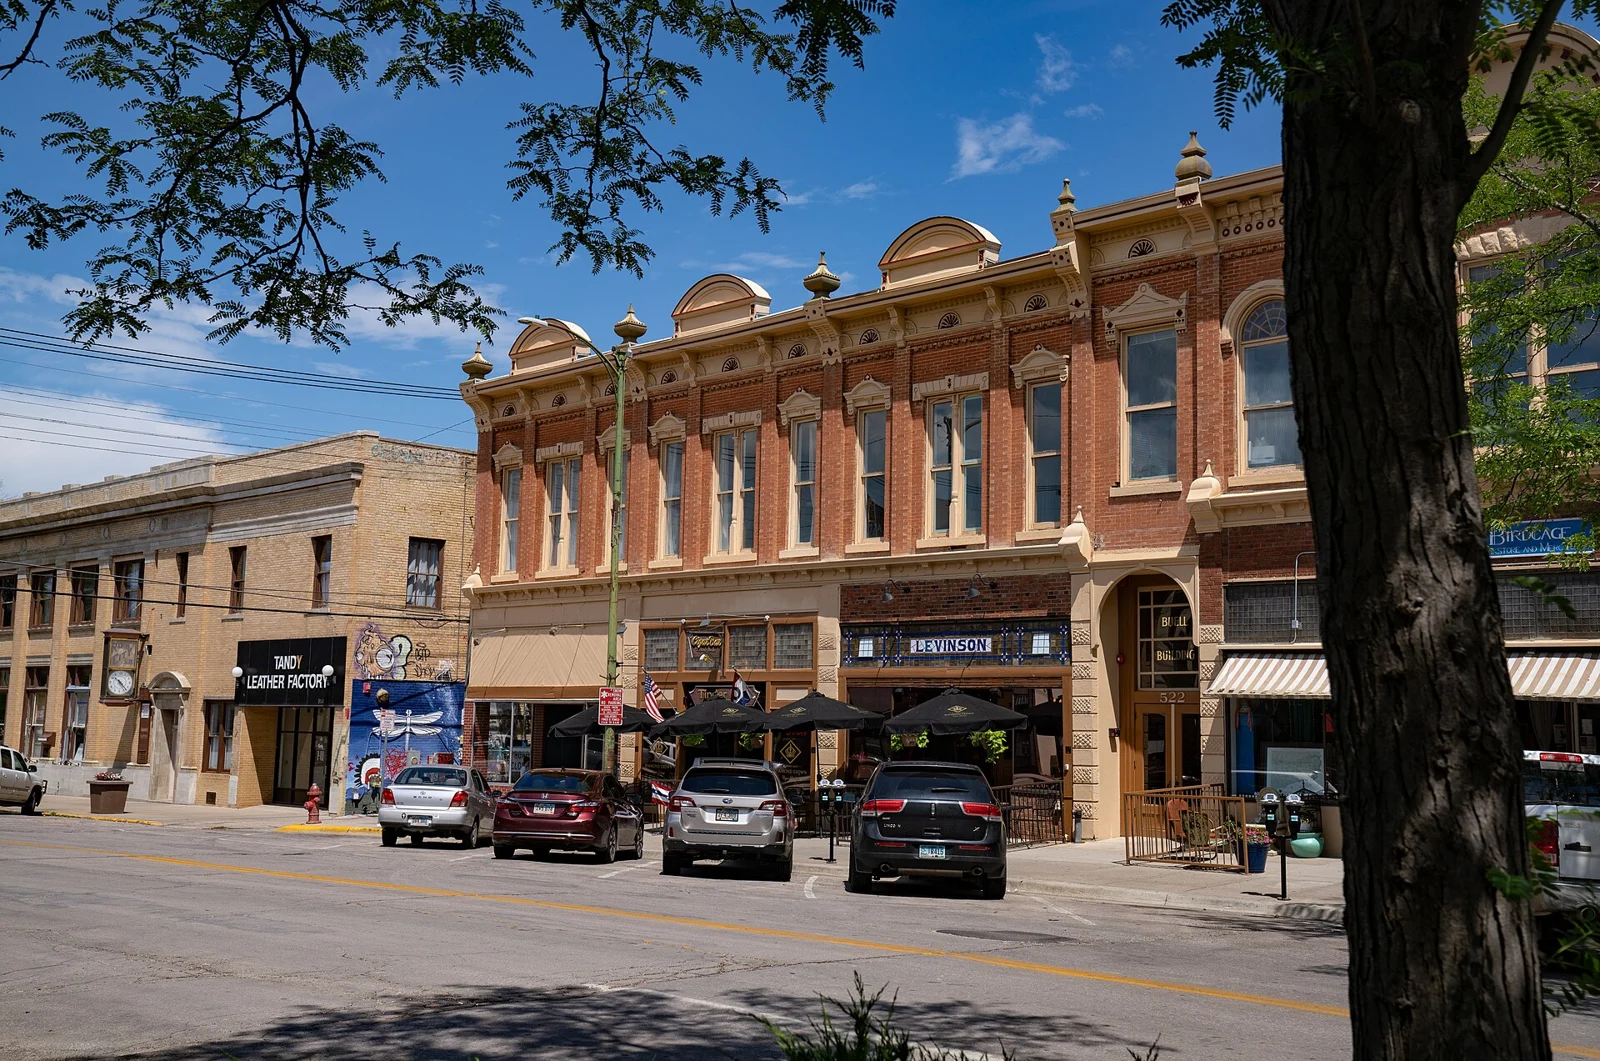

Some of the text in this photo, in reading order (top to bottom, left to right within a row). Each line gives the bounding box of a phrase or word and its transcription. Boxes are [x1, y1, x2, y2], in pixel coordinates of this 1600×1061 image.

[1489, 527, 1571, 545] BIRDCAGE
[1523, 545, 1538, 553] AND
[1162, 616, 1187, 627] BUELL
[916, 639, 987, 652] LEVINSON
[1157, 649, 1195, 661] BUILDING
[274, 655, 303, 670] TANDY
[247, 674, 328, 690] LEATHER FACTORY
[697, 689, 728, 699] Tinder
[1159, 692, 1185, 703] 522
